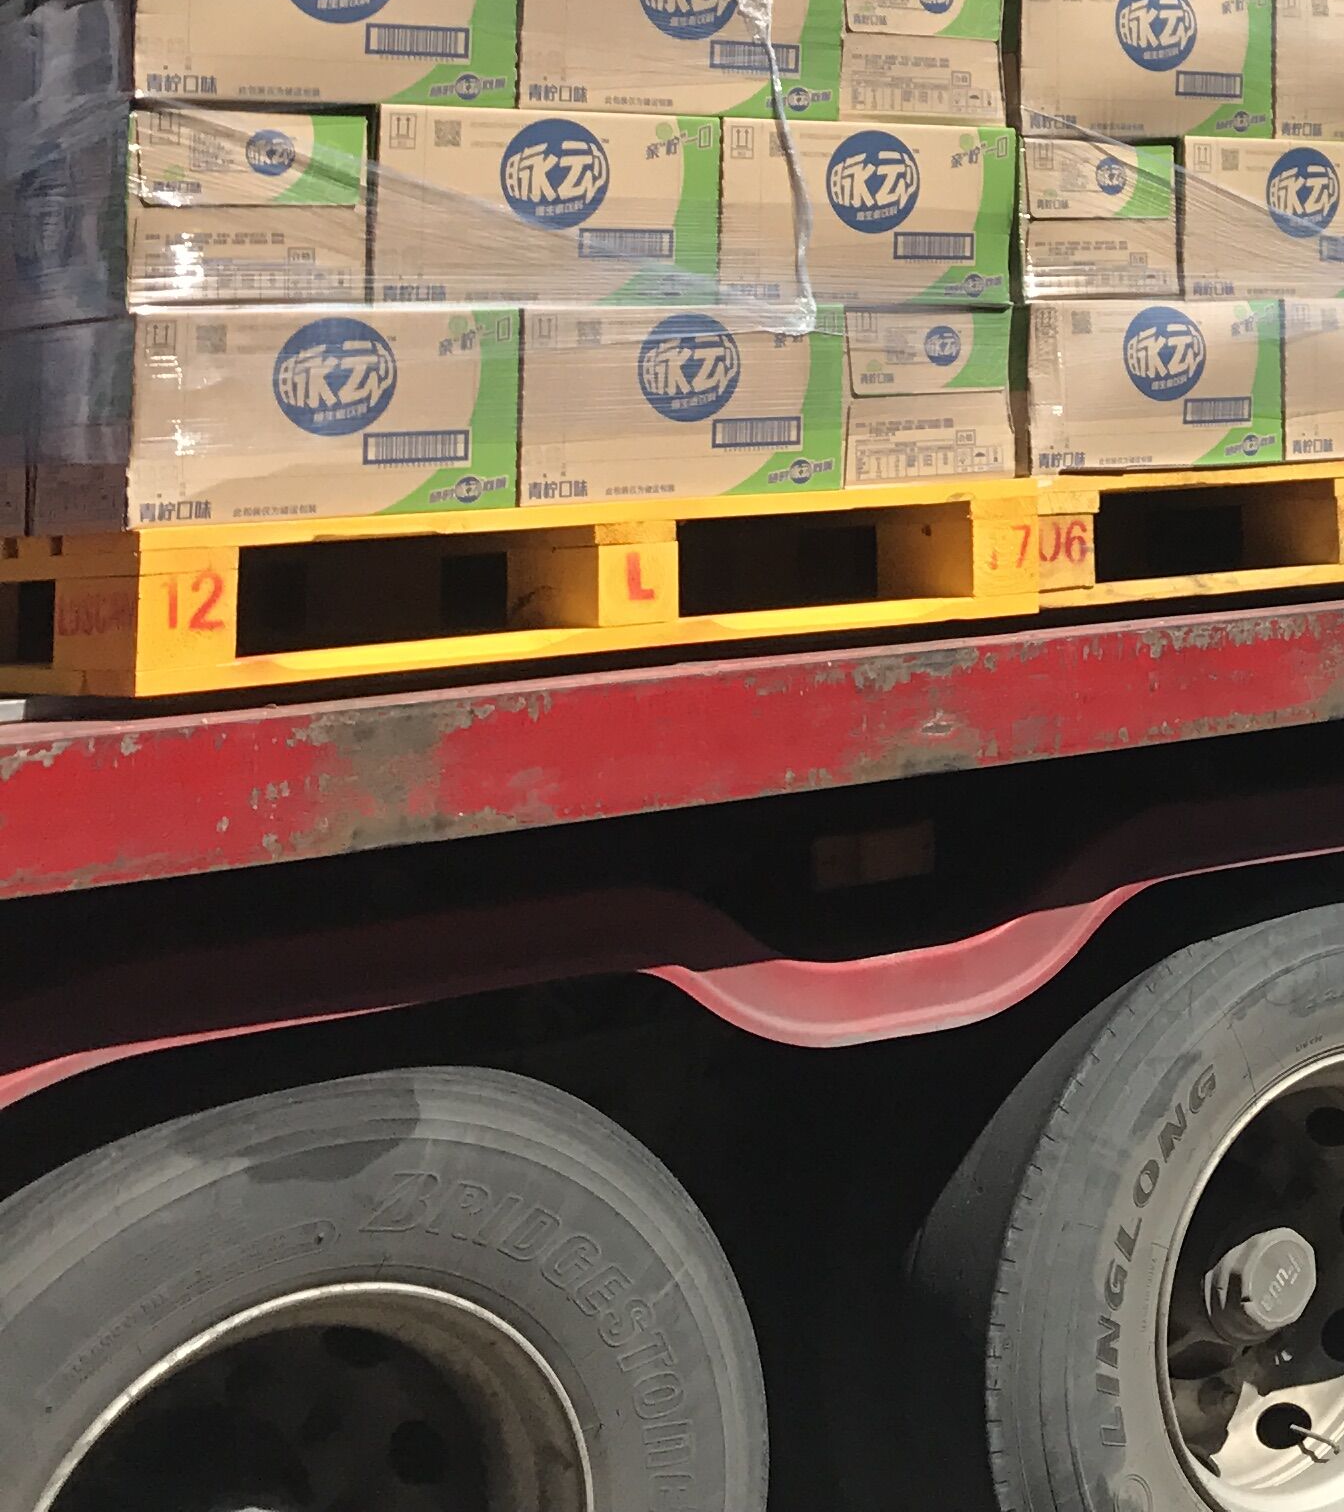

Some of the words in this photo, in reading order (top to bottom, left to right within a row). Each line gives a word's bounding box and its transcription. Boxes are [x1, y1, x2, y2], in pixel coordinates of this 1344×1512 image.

[145, 74, 218, 95] 青柠口味
[528, 84, 588, 104] 青柠口味
[504, 141, 606, 205] 脉动
[830, 151, 917, 211] 脉动
[1269, 165, 1337, 219] 脉动
[277, 340, 395, 410] 脉动
[641, 333, 738, 397] 脉动
[1126, 323, 1202, 381] 脉动
[138, 500, 211, 520] 青柠口味
[528, 478, 588, 499] 青柠口味
[166, 572, 225, 632] 12
[625, 553, 656, 602] L
[1095, 1064, 1218, 1448] LINGLONG
